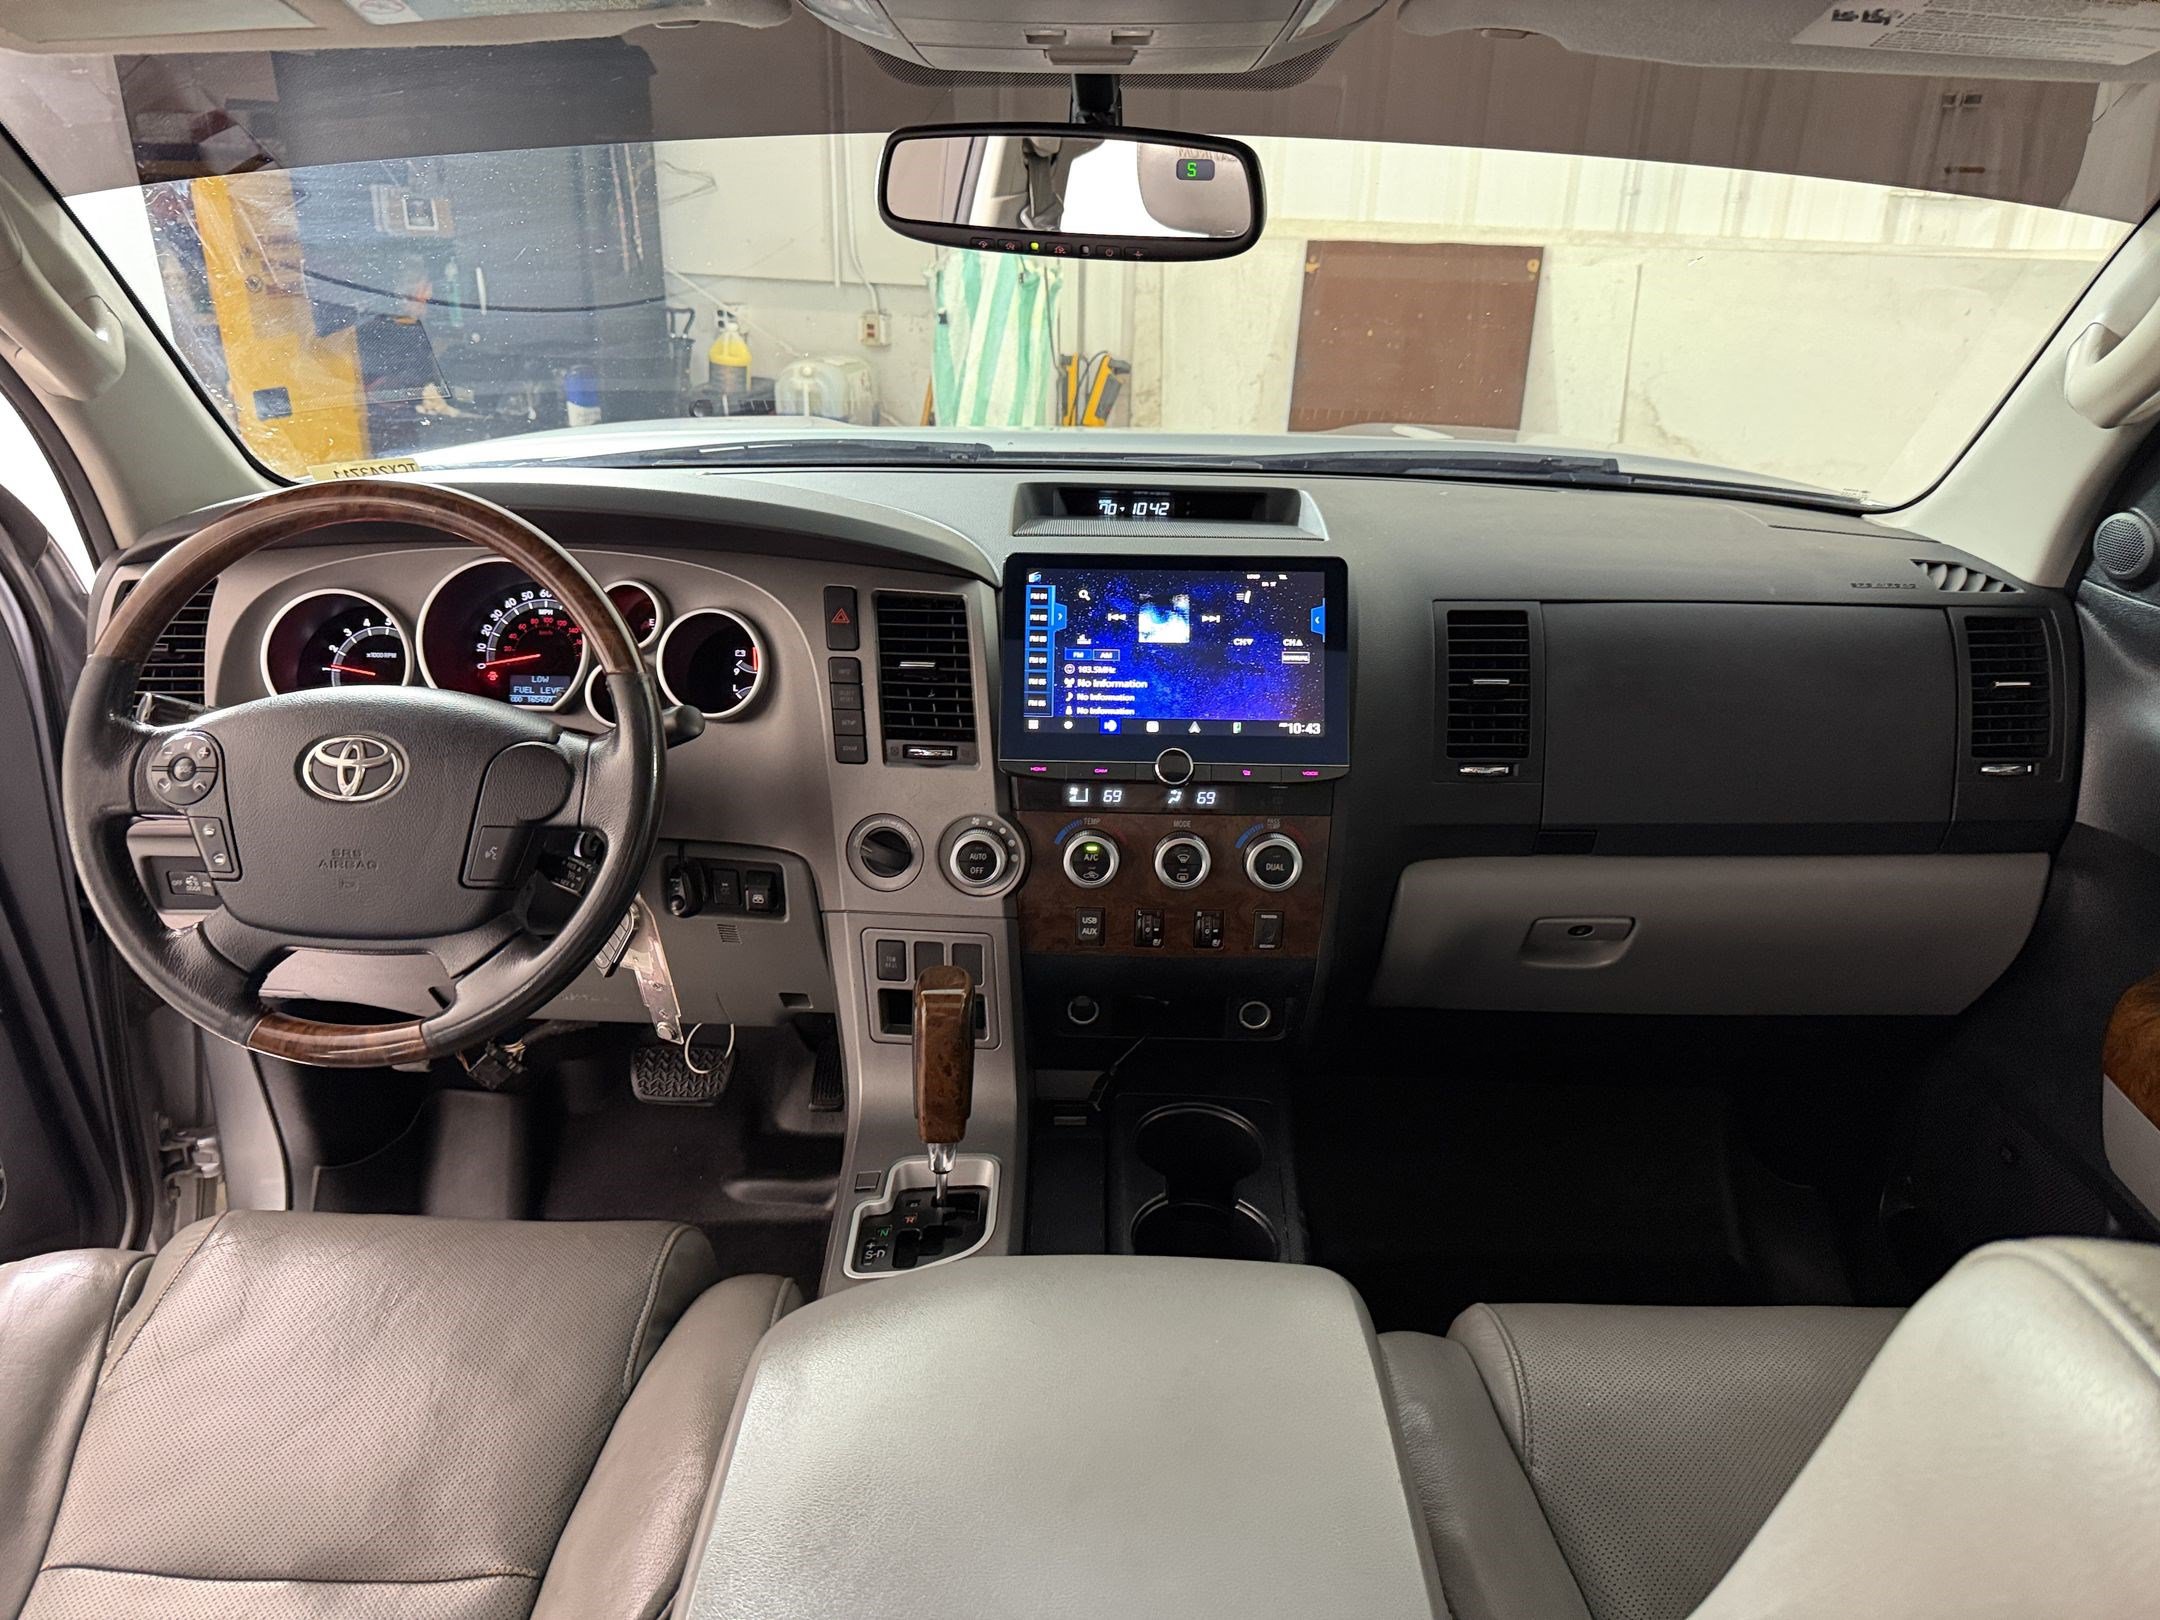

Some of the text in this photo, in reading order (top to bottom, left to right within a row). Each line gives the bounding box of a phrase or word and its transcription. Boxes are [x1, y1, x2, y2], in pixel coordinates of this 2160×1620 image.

[1187, 162, 1197, 177] S
[521, 590, 535, 600] 50
[504, 597, 517, 609] 40
[490, 609, 503, 622] 30
[363, 618, 371, 627] 4
[649, 618, 656, 626] E
[343, 628, 352, 637] 3
[481, 624, 493, 637] 20
[328, 645, 339, 653] 2
[476, 643, 487, 653] 10
[531, 675, 550, 683] LOW
[1077, 678, 1148, 688] No Information
[513, 686, 535, 694] FUEL
[732, 684, 739, 692] L
[1288, 722, 1321, 735] 10:43
[1102, 789, 1122, 803] 69
[1196, 791, 1216, 805] 69
[1173, 820, 1192, 828] MODE
[969, 852, 988, 861] AUTO
[1084, 853, 1099, 861] A/C
[969, 866, 985, 875] OFF
[1265, 862, 1286, 872] DUAL
[1082, 916, 1098, 925] USB
[1082, 927, 1098, 936] AUX
